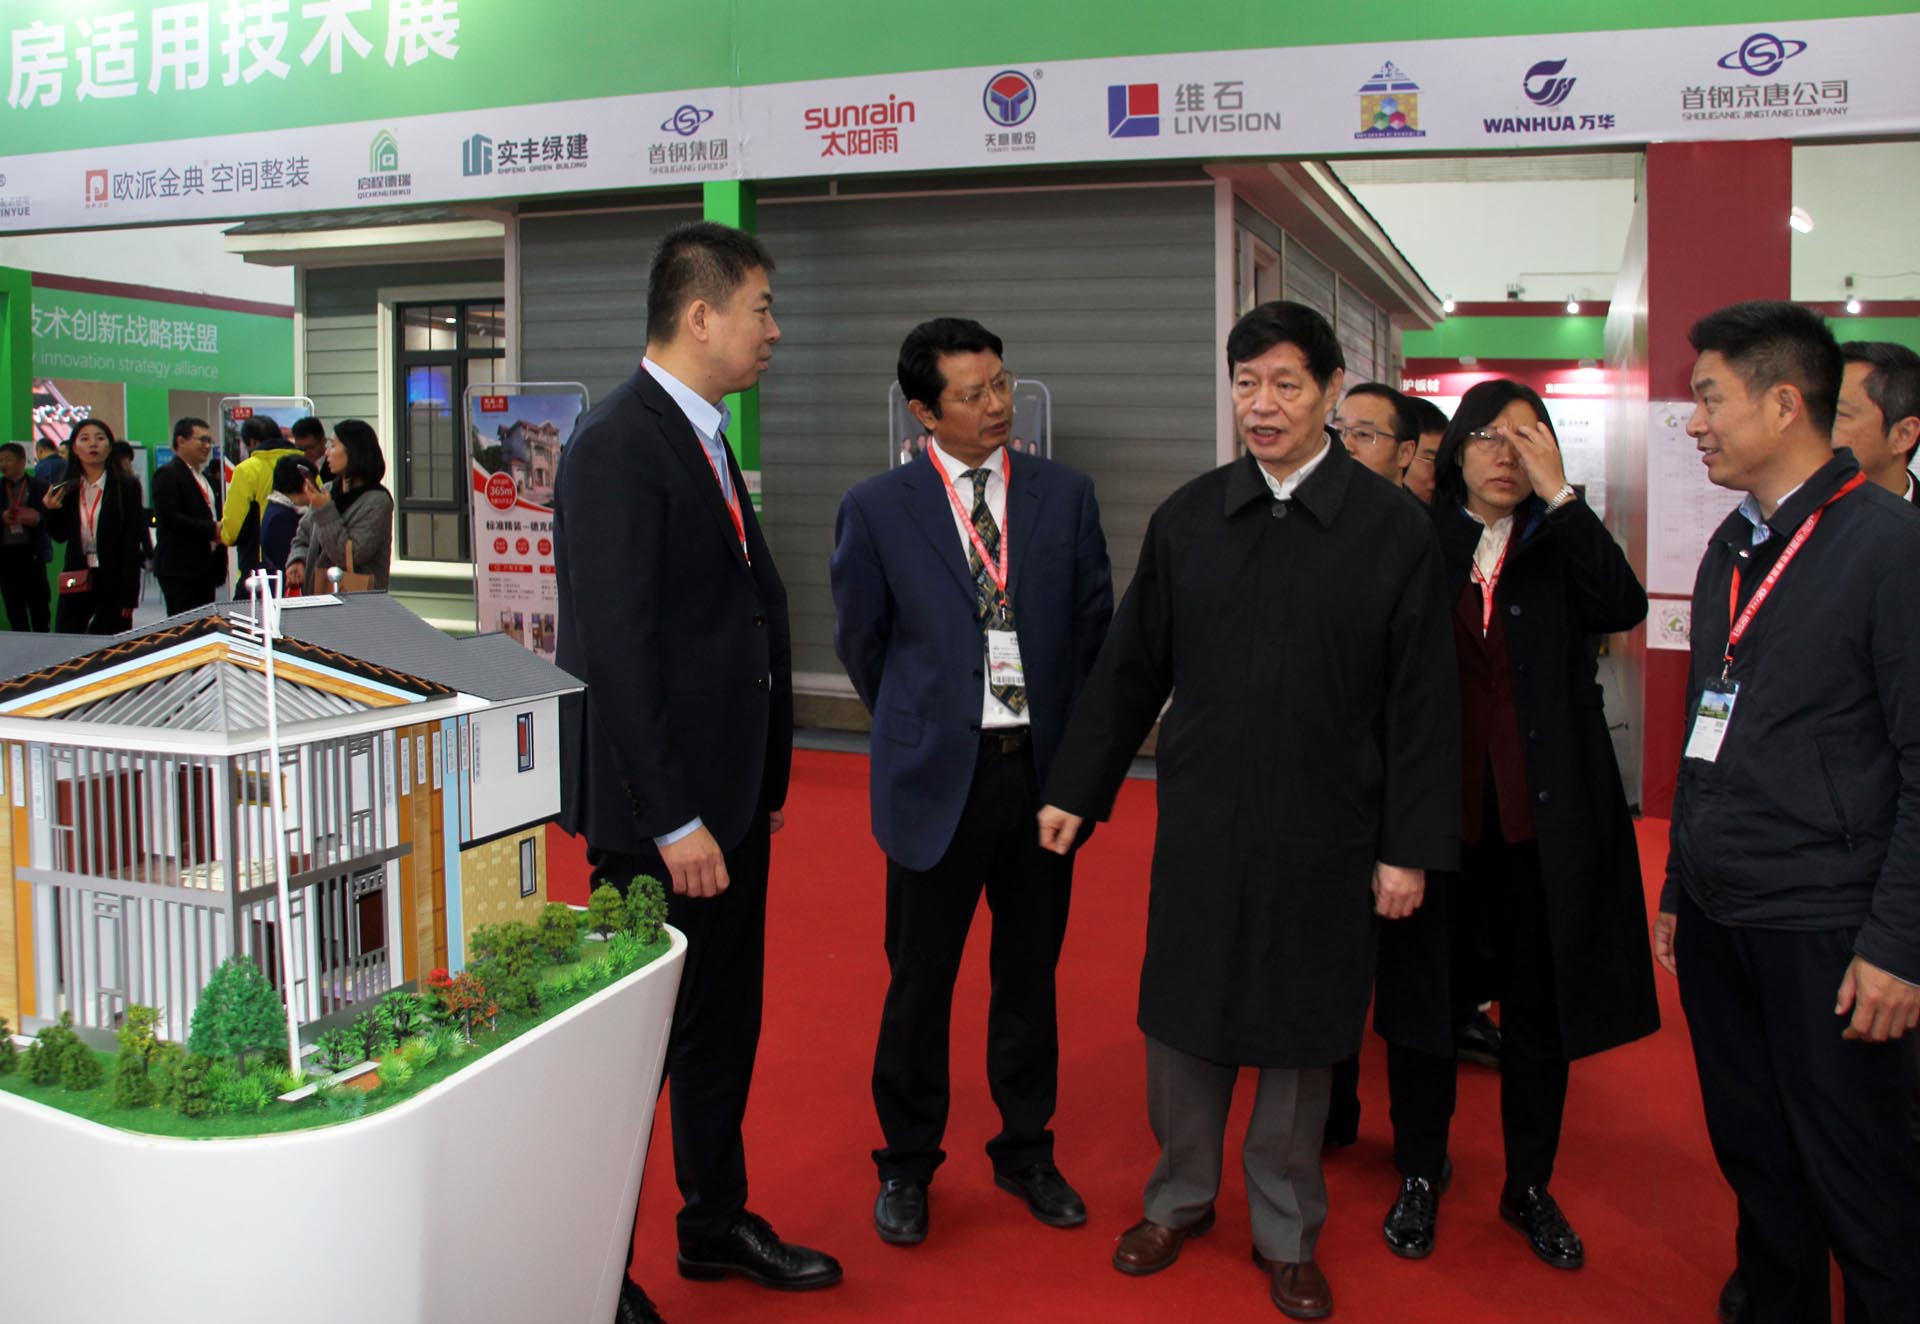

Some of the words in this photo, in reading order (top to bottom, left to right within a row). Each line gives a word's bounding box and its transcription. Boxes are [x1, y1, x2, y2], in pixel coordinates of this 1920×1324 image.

[8, 0, 461, 110] 房适用技术展
[1174, 81, 1244, 112] 维石
[1680, 80, 1849, 110] 首钢京唐公司
[804, 94, 916, 130] sunrain
[1174, 112, 1282, 135] LIVISION
[1483, 116, 1576, 133] WANHUA
[1579, 114, 1615, 131] 万华
[497, 133, 588, 167] 实丰绿建
[648, 139, 728, 165] 首钢集团
[821, 127, 899, 157] 太阳雨
[113, 165, 205, 201] 欧派金典
[211, 155, 310, 194] 空间整装
[40, 351, 115, 371] innovation
[119, 357, 170, 378] strategy
[174, 362, 219, 379] alliance
[1400, 378, 1440, 394] 护板材
